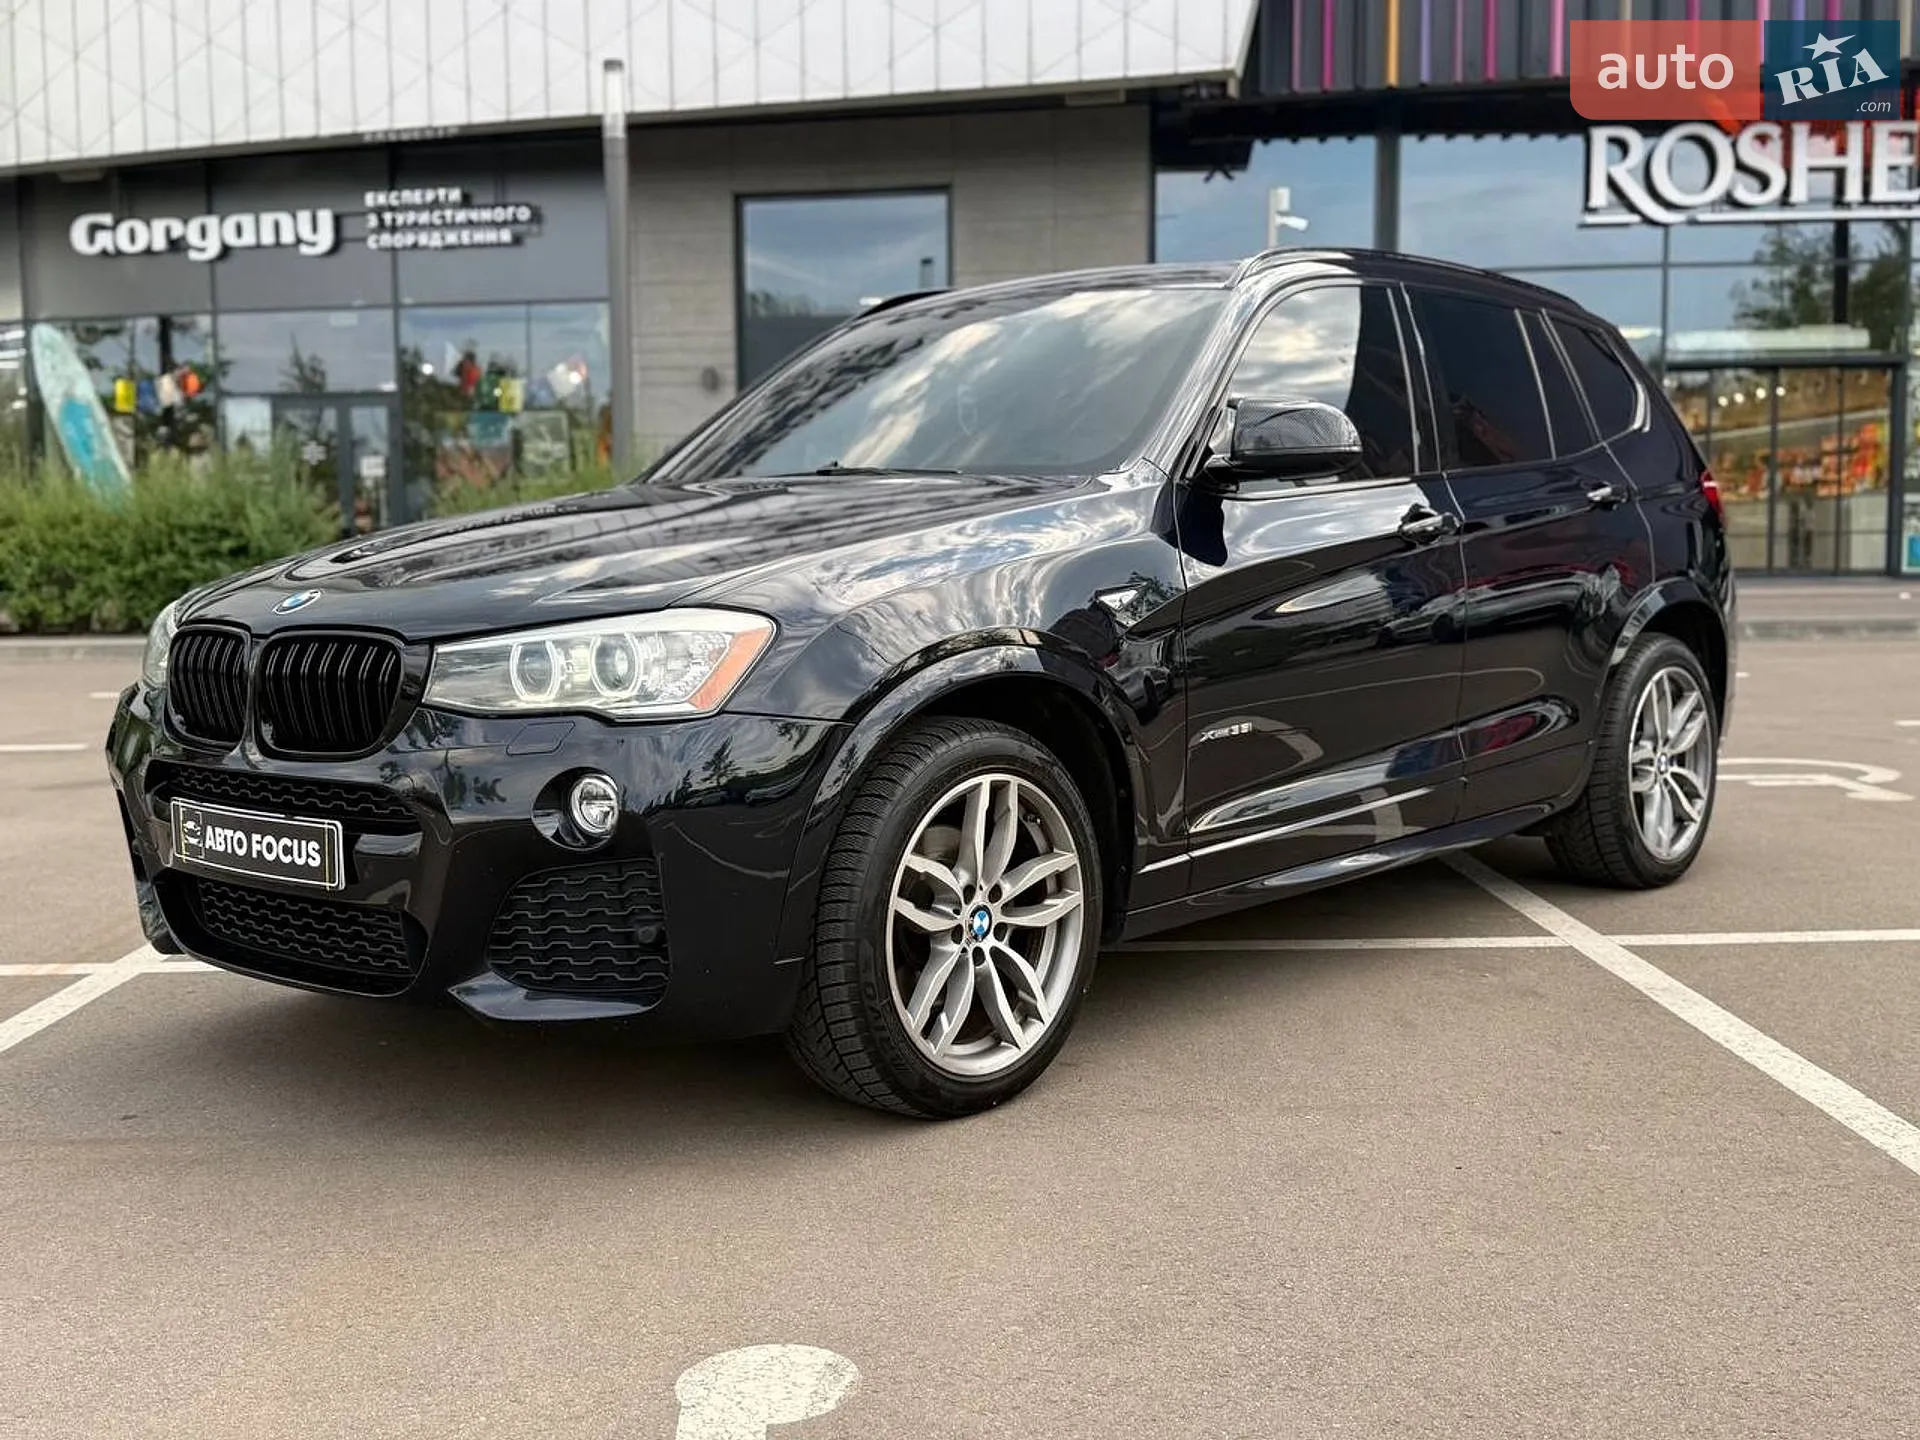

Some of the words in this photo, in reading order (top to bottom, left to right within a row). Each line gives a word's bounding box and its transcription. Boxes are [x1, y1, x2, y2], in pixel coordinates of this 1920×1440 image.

[1588, 121, 1920, 224] ROSHE
[364, 187, 462, 208] ЕКСПЕРТИ
[69, 208, 335, 261] Gorgany
[251, 833, 321, 868] FOCUS
